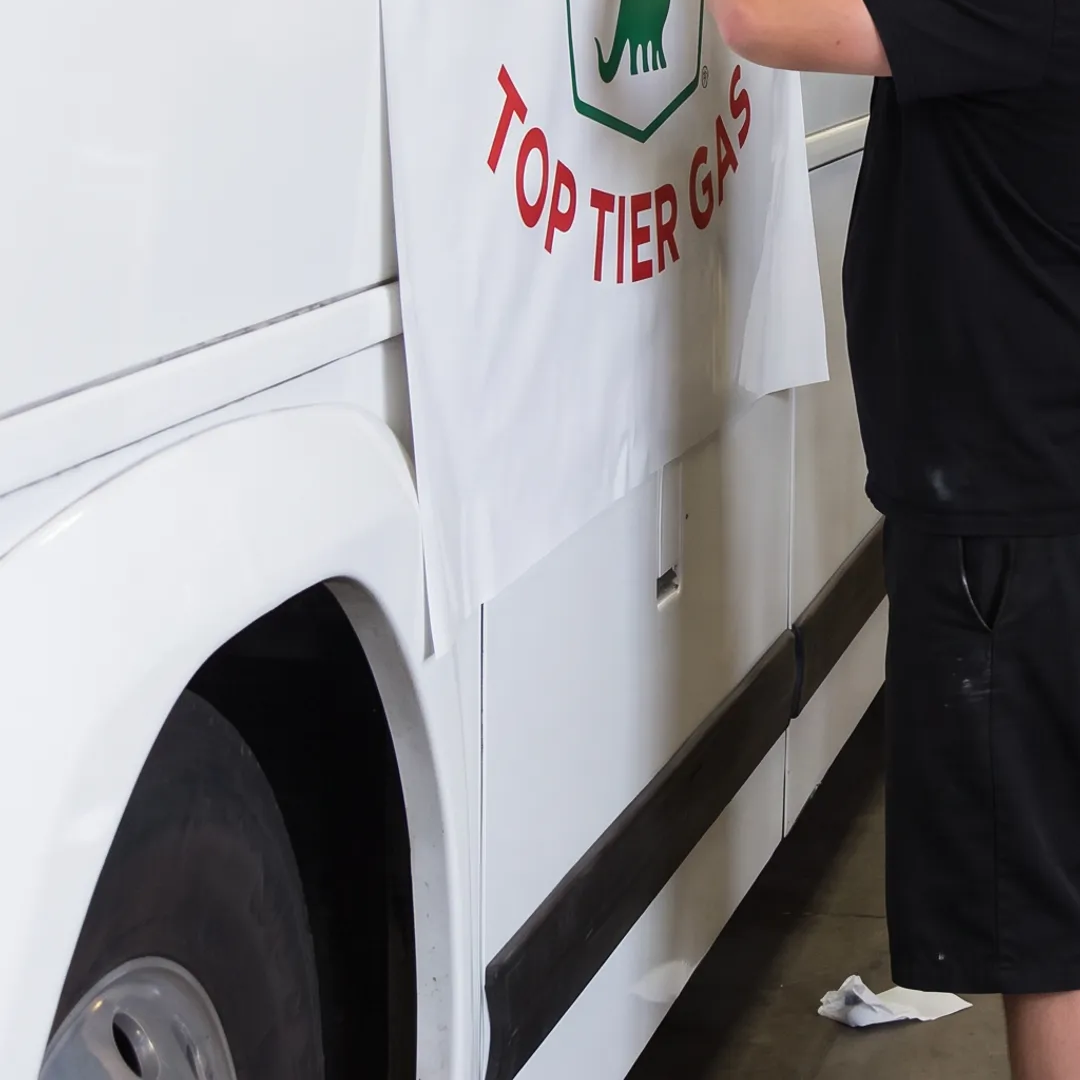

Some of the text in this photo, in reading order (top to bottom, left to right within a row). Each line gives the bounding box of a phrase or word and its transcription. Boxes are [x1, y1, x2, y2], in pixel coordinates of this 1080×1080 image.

[486, 63, 753, 284] TOP TIER GAS
